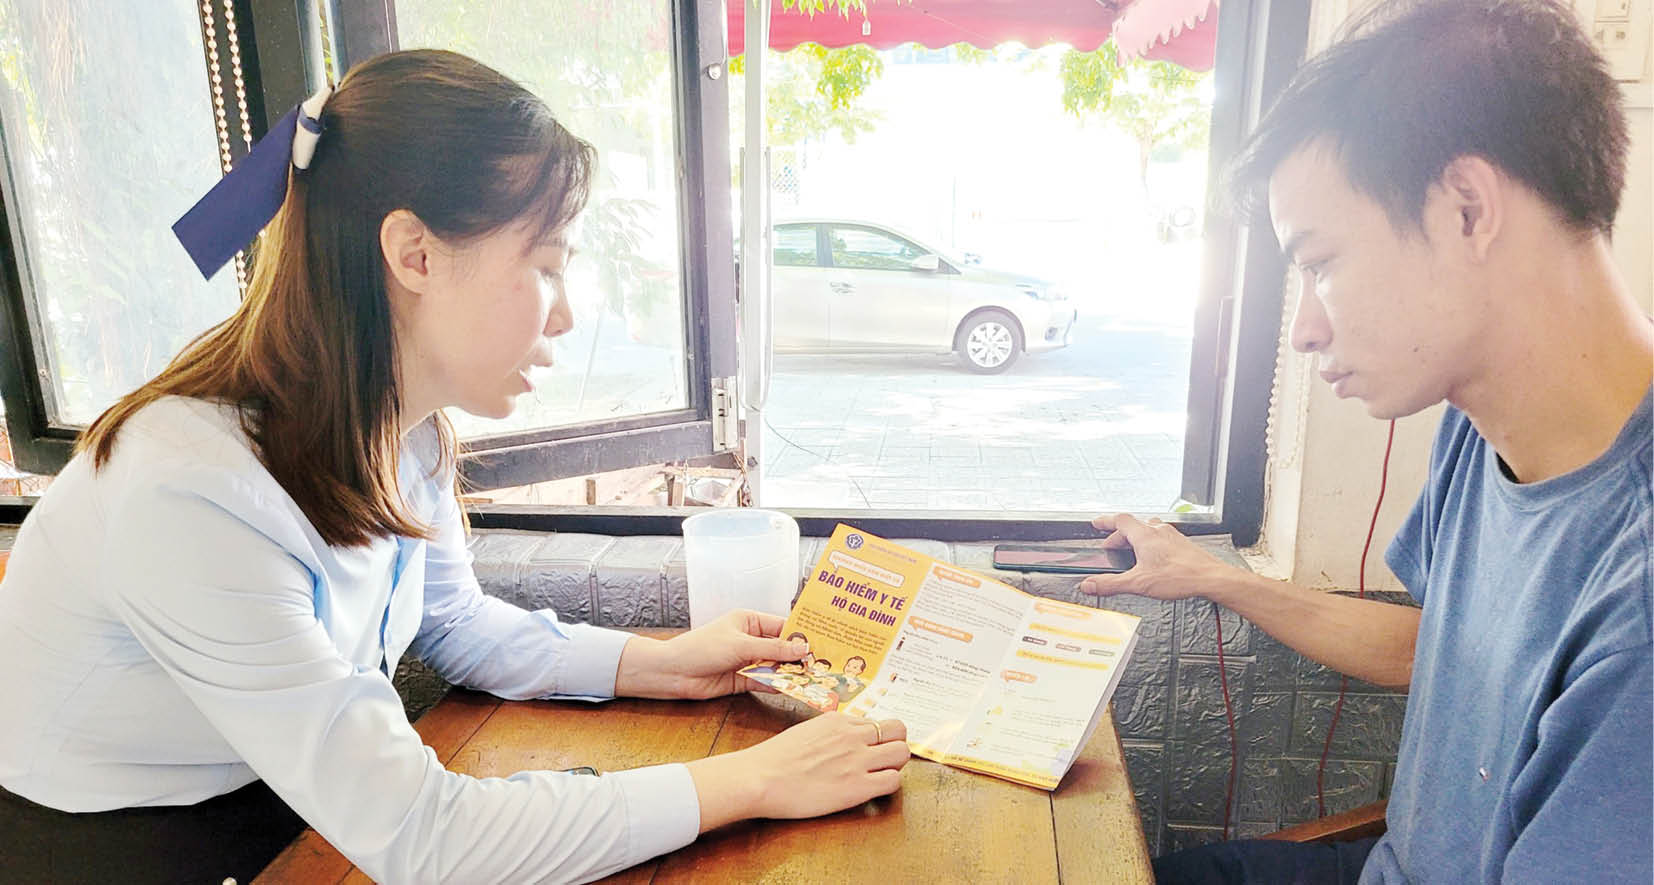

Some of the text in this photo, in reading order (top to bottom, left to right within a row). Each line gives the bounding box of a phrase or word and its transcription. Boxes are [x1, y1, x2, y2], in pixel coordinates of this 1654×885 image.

[818, 569, 845, 588] BẢO
[845, 580, 878, 602] HIỂM
[879, 593, 888, 605] Y
[890, 596, 909, 611] TẾ
[831, 595, 848, 611] HỘ
[848, 600, 867, 617] GIA
[868, 609, 897, 627] ĐÌNH
